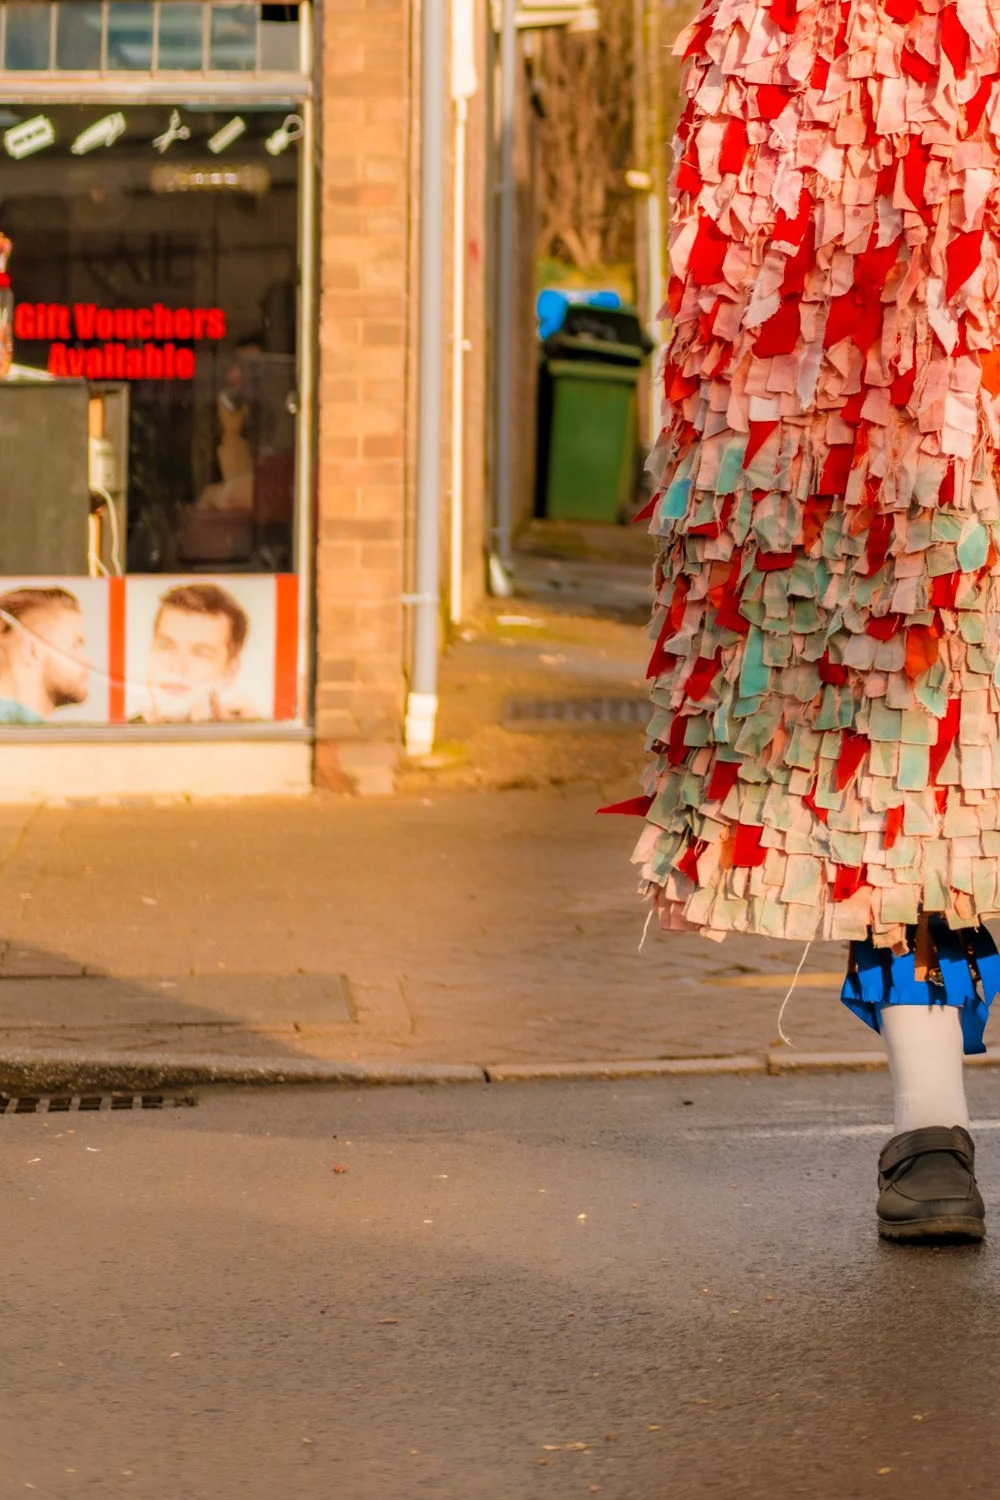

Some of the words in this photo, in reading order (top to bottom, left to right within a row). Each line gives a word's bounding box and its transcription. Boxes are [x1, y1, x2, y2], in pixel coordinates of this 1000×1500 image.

[14, 302, 71, 339] Gift
[73, 302, 226, 339] Vouchers
[47, 343, 196, 379] Available
